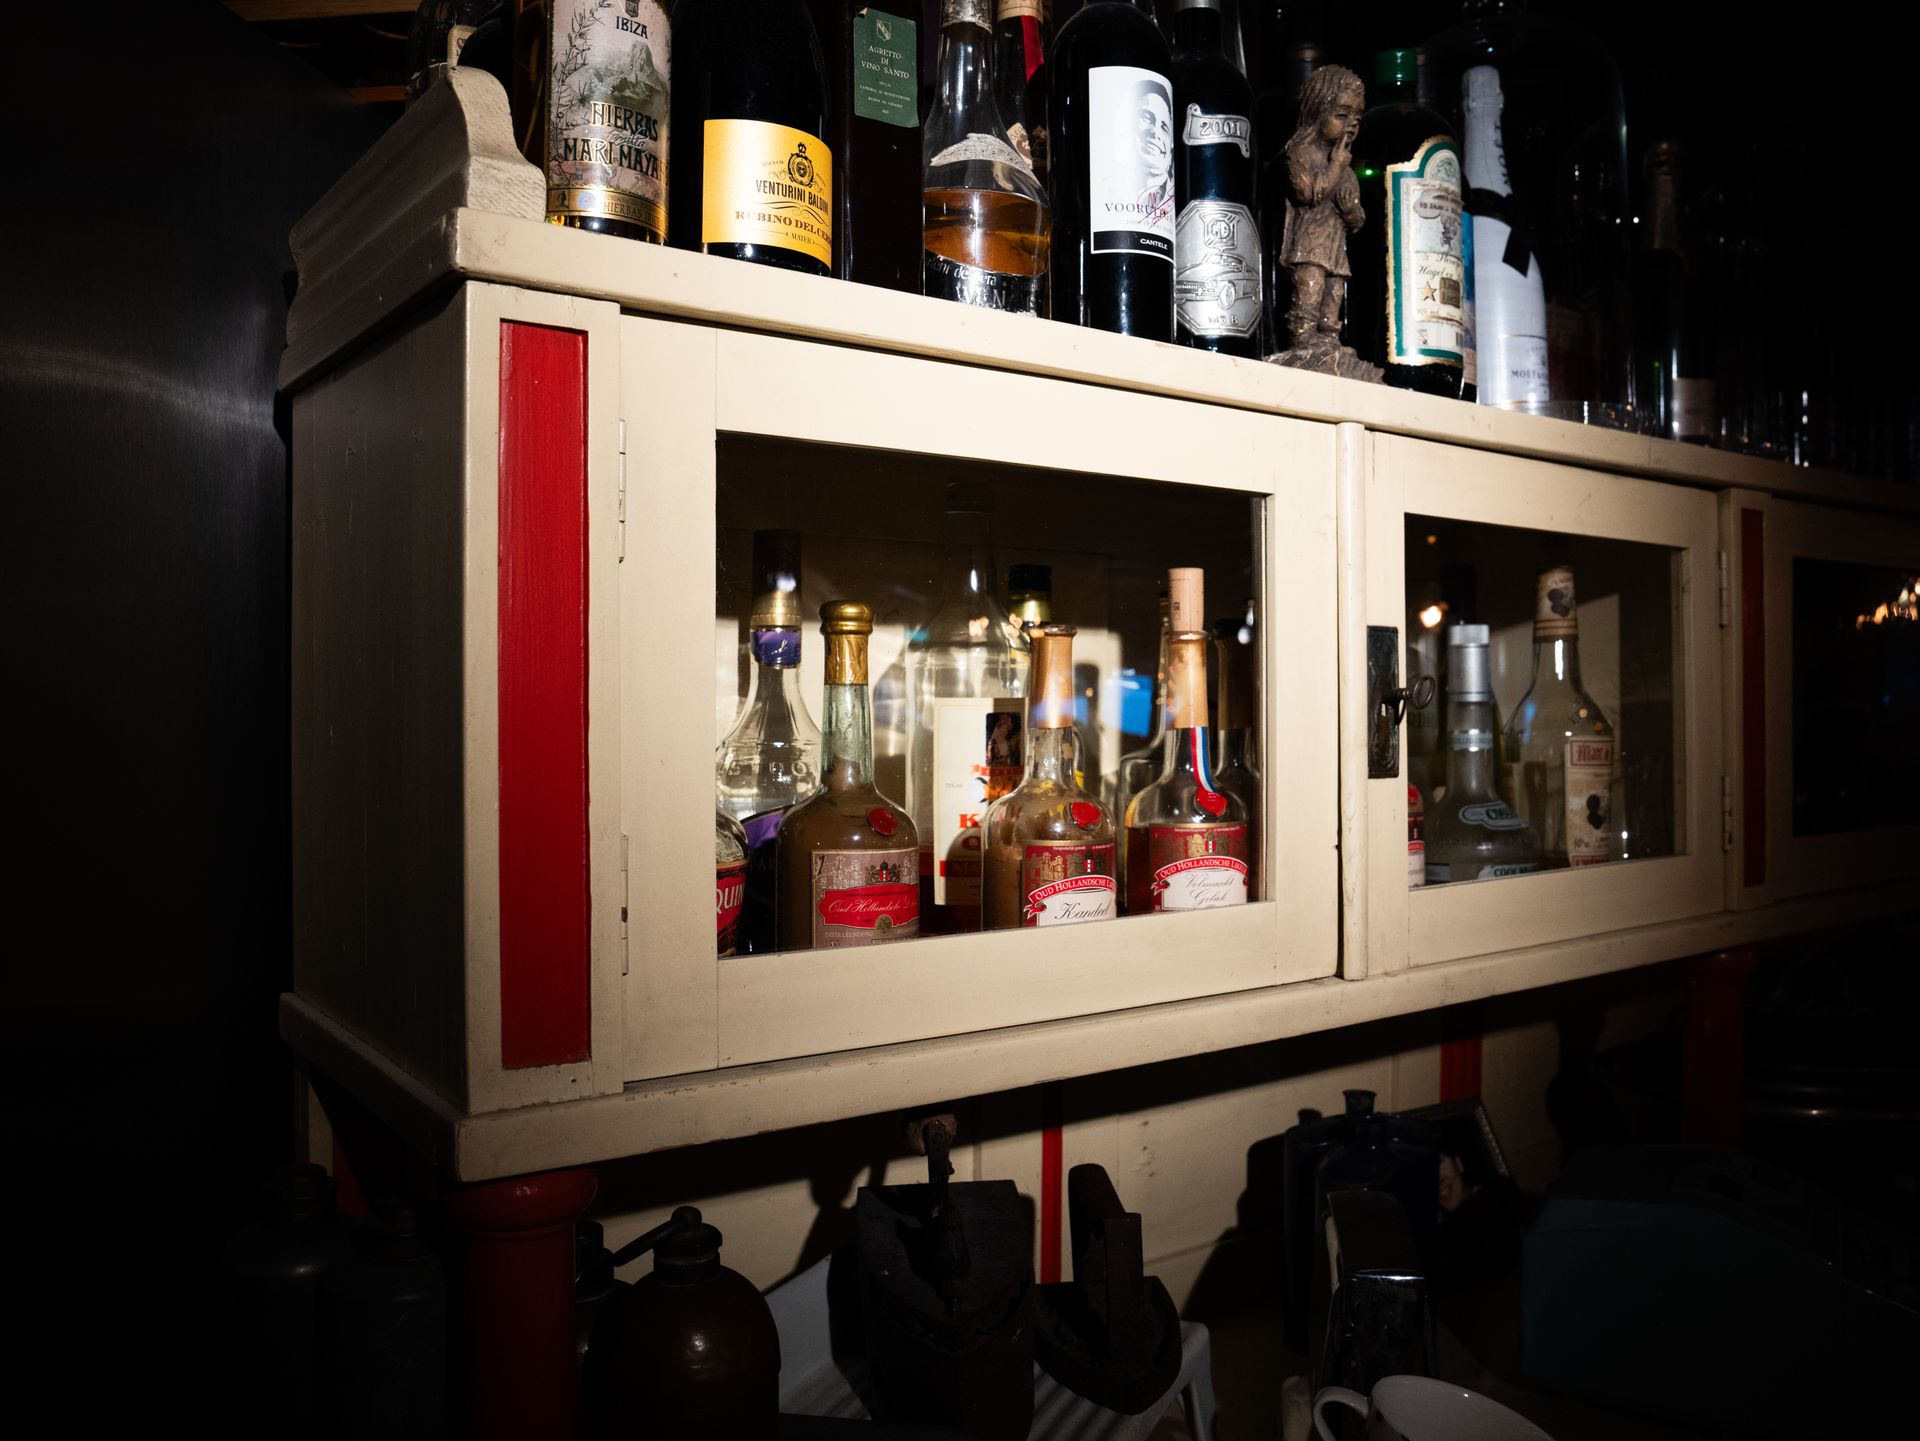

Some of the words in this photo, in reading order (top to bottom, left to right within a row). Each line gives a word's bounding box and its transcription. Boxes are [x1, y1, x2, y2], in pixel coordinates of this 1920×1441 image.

[615, 15, 649, 40] IBIZA
[868, 45, 902, 60] AGRETTO
[880, 57, 889, 66] DI
[860, 60, 881, 72] VINO
[883, 67, 910, 79] SANTO
[590, 101, 659, 143] HIERBAS
[1200, 121, 1242, 137] 2001
[755, 178, 806, 204] VENTURINI
[603, 200, 642, 219] HIERBAS
[734, 210, 793, 226] RBINO
[794, 219, 816, 234] DEL
[1139, 238, 1169, 251] CANTELE
[1159, 864, 1177, 879] OUD
[1176, 858, 1230, 875] HOLLANDSCHE
[1035, 887, 1055, 902] OUD
[1054, 878, 1106, 895] HOLLANDSCHE
